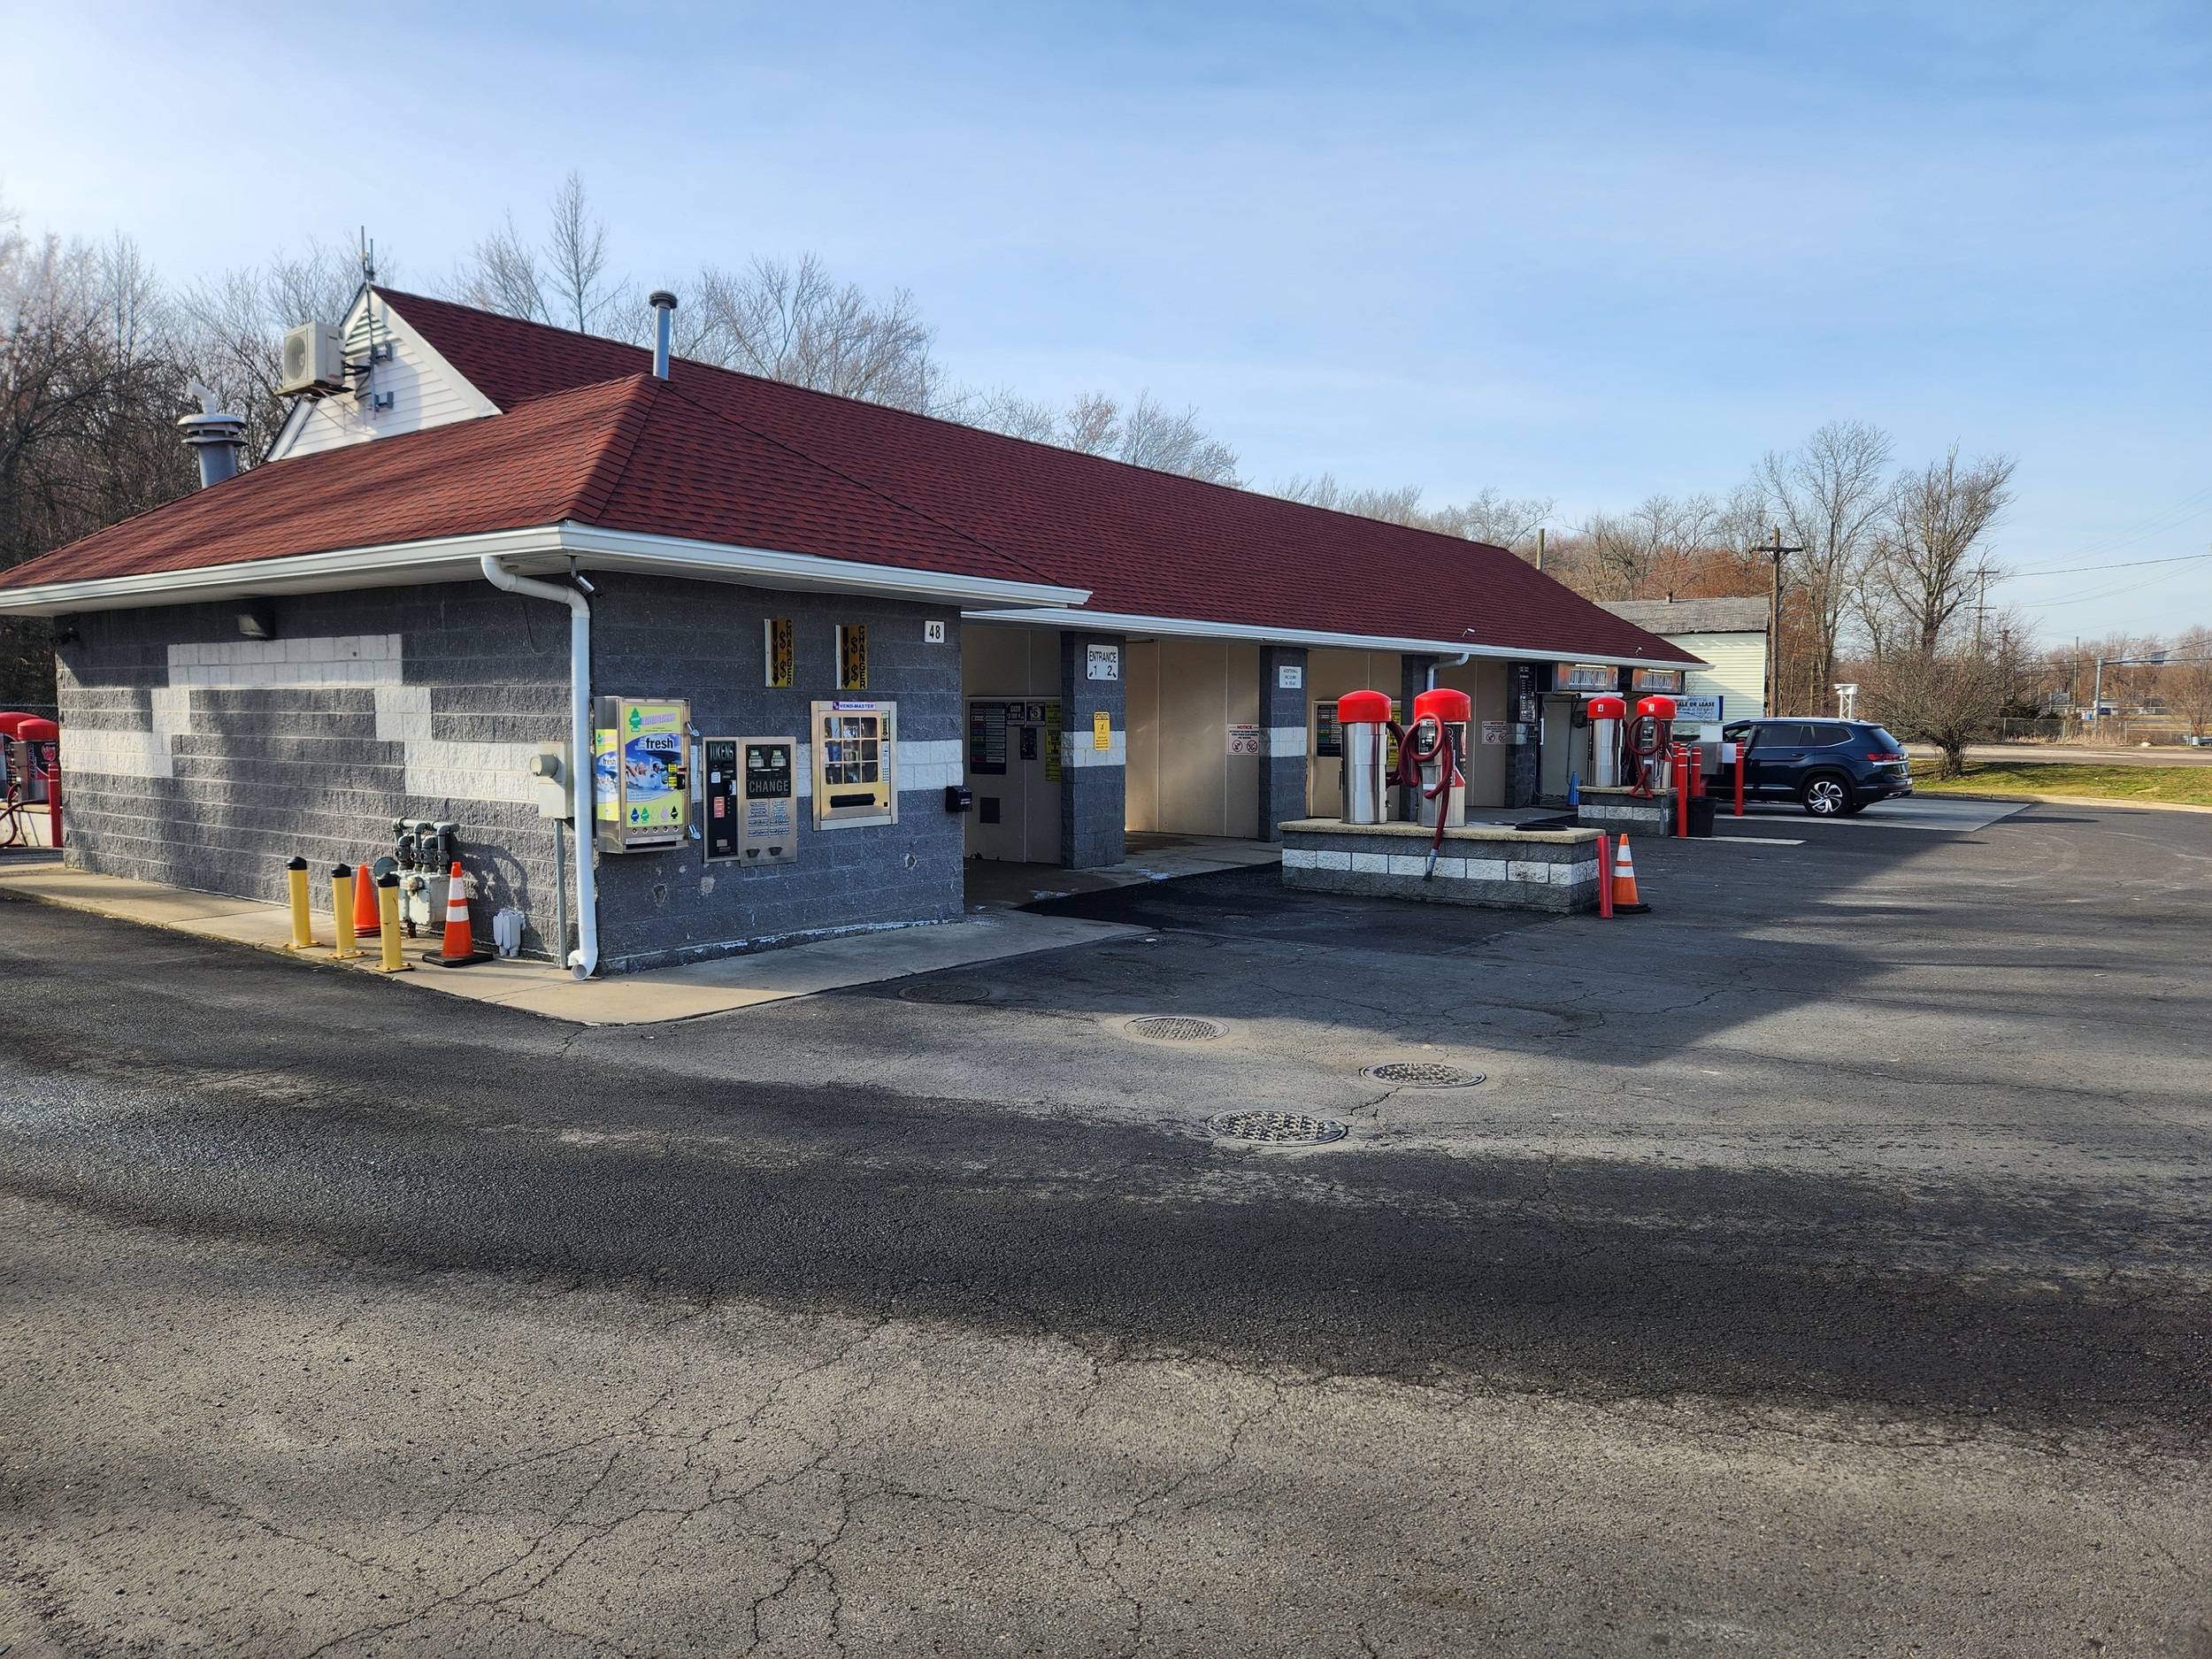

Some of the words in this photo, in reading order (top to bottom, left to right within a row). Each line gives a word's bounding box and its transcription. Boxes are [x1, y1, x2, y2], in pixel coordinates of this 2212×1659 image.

[929, 625, 941, 640] 48
[1089, 650, 1117, 663] ENTRANCE
[1094, 664, 1097, 676] 1
[1107, 664, 1112, 676] 2
[646, 737, 673, 749] fresh
[709, 743, 734, 761] TOKENS
[749, 780, 789, 793] CHANGE
